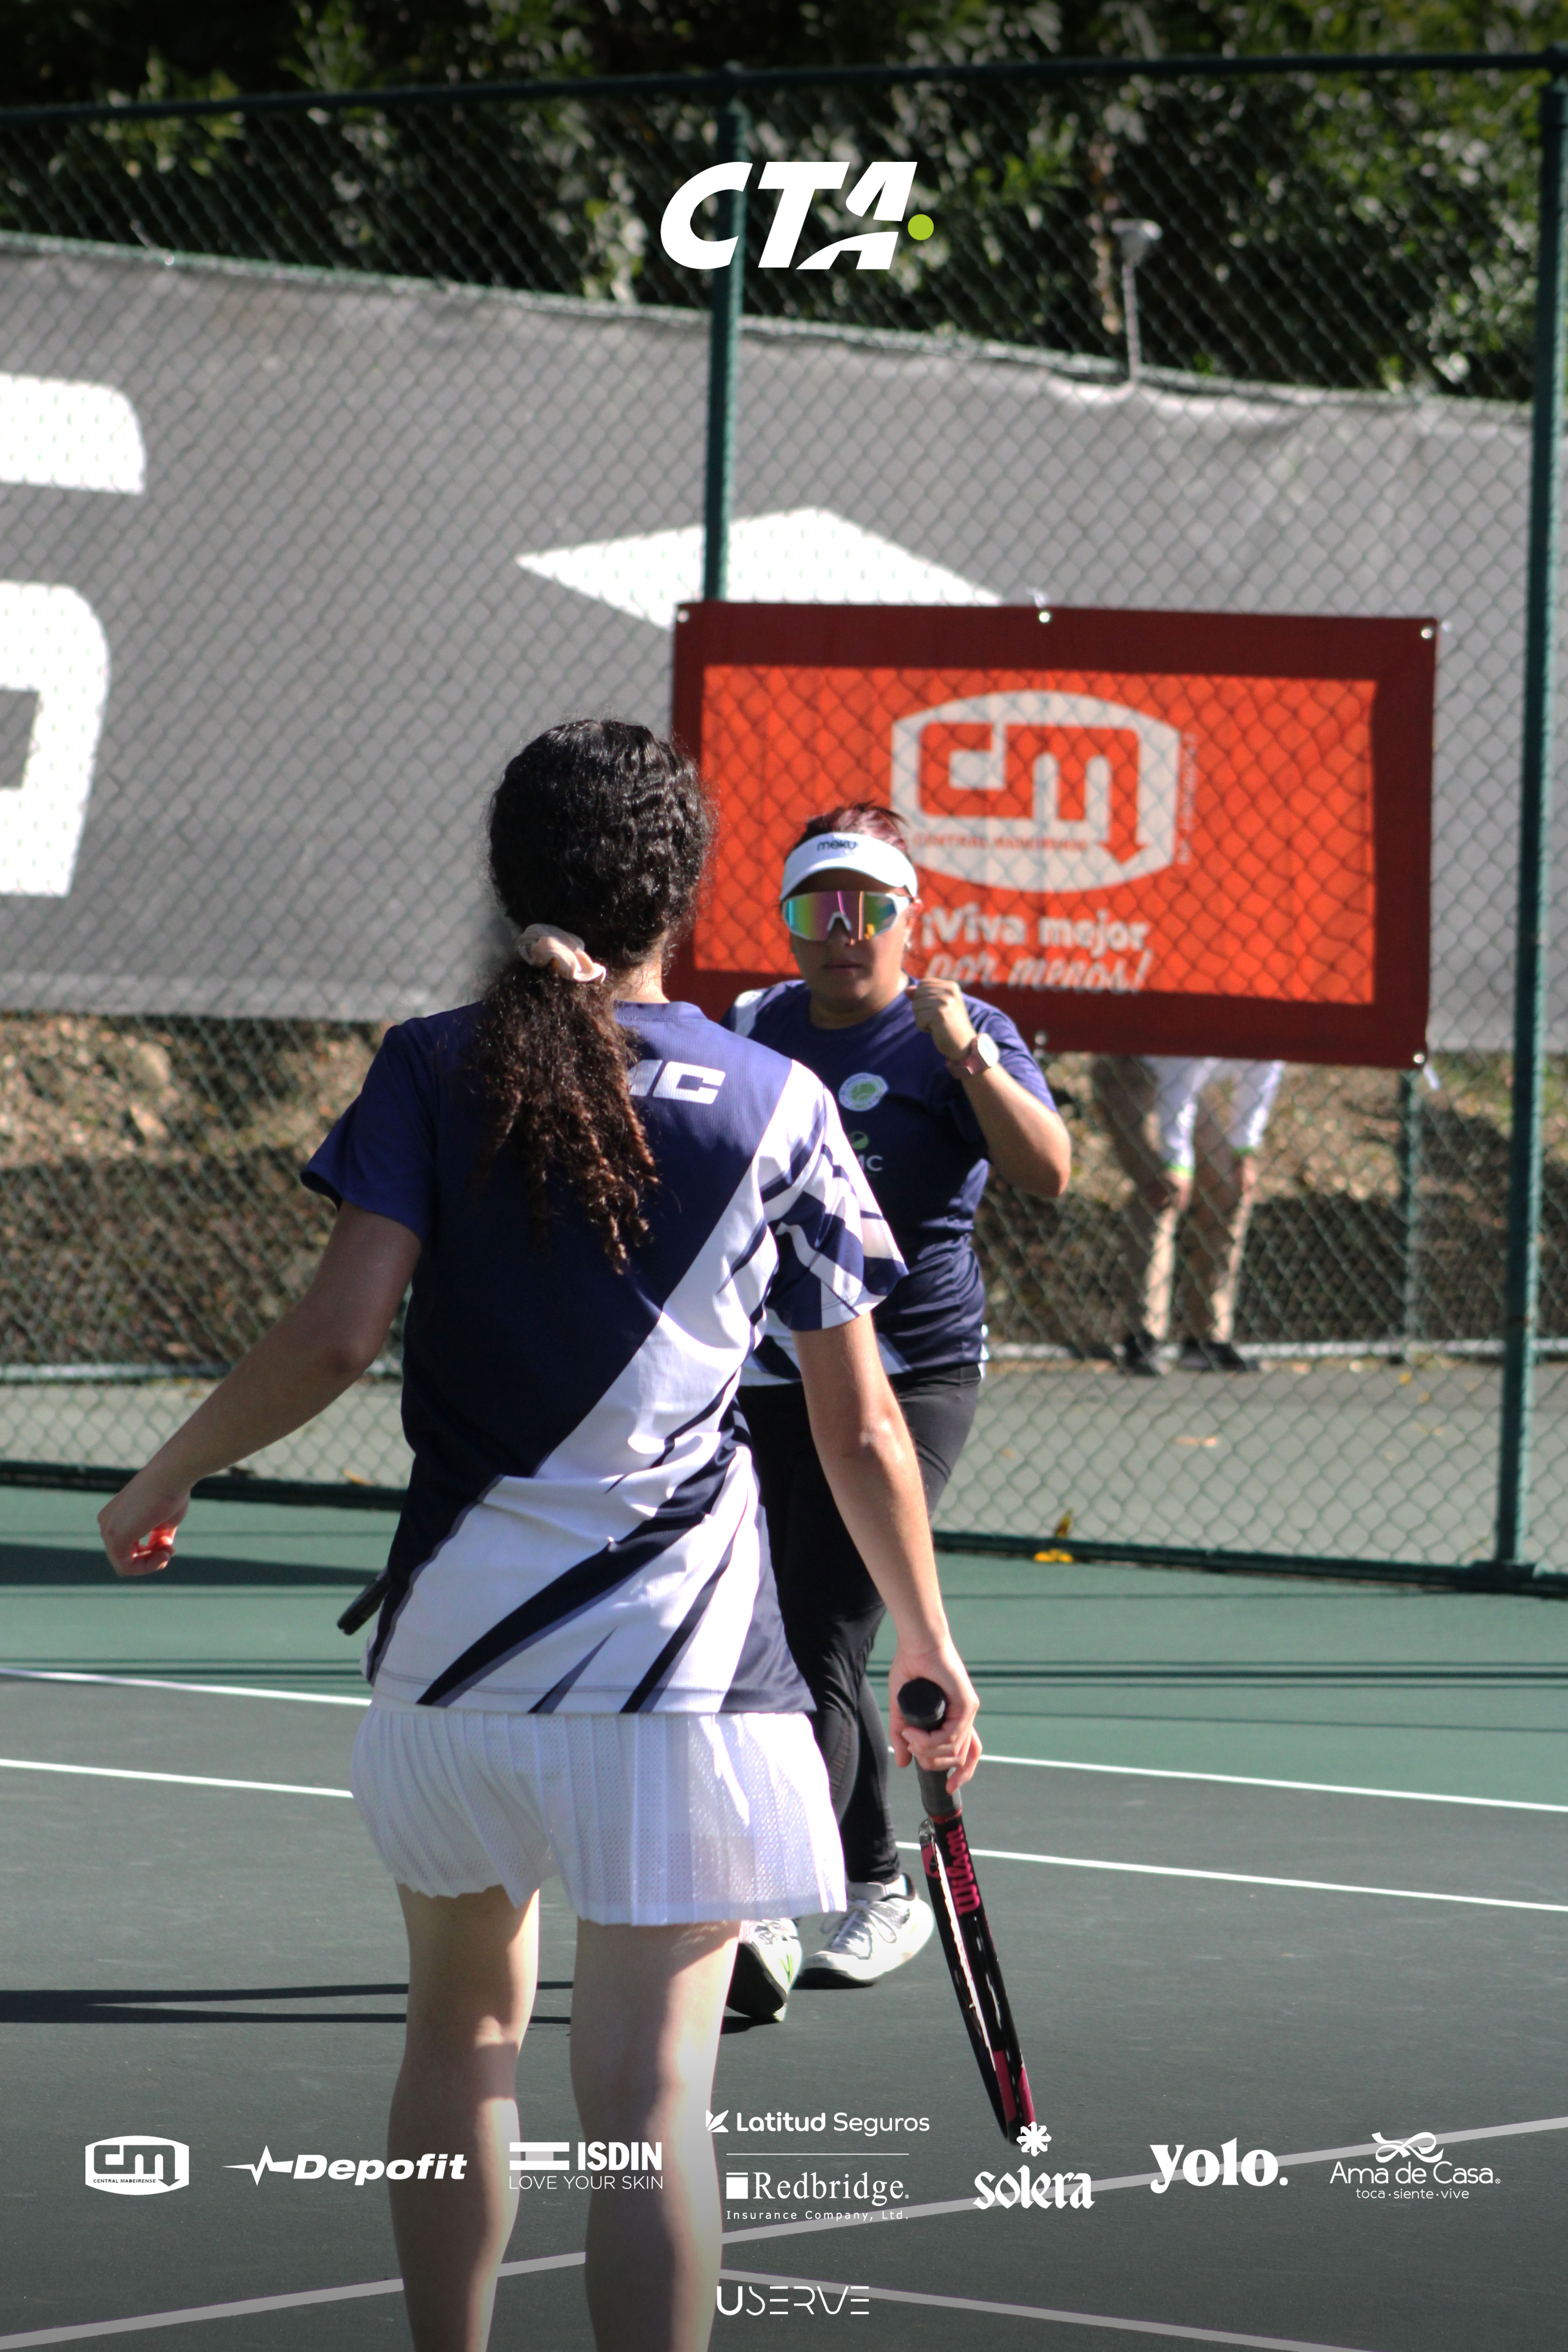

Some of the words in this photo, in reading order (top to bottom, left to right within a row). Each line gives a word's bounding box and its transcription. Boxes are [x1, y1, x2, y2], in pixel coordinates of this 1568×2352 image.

[921, 902, 1026, 949] ¡Viva
[1038, 909, 1151, 958] mejor
[944, 1824, 980, 1916] Wilson
